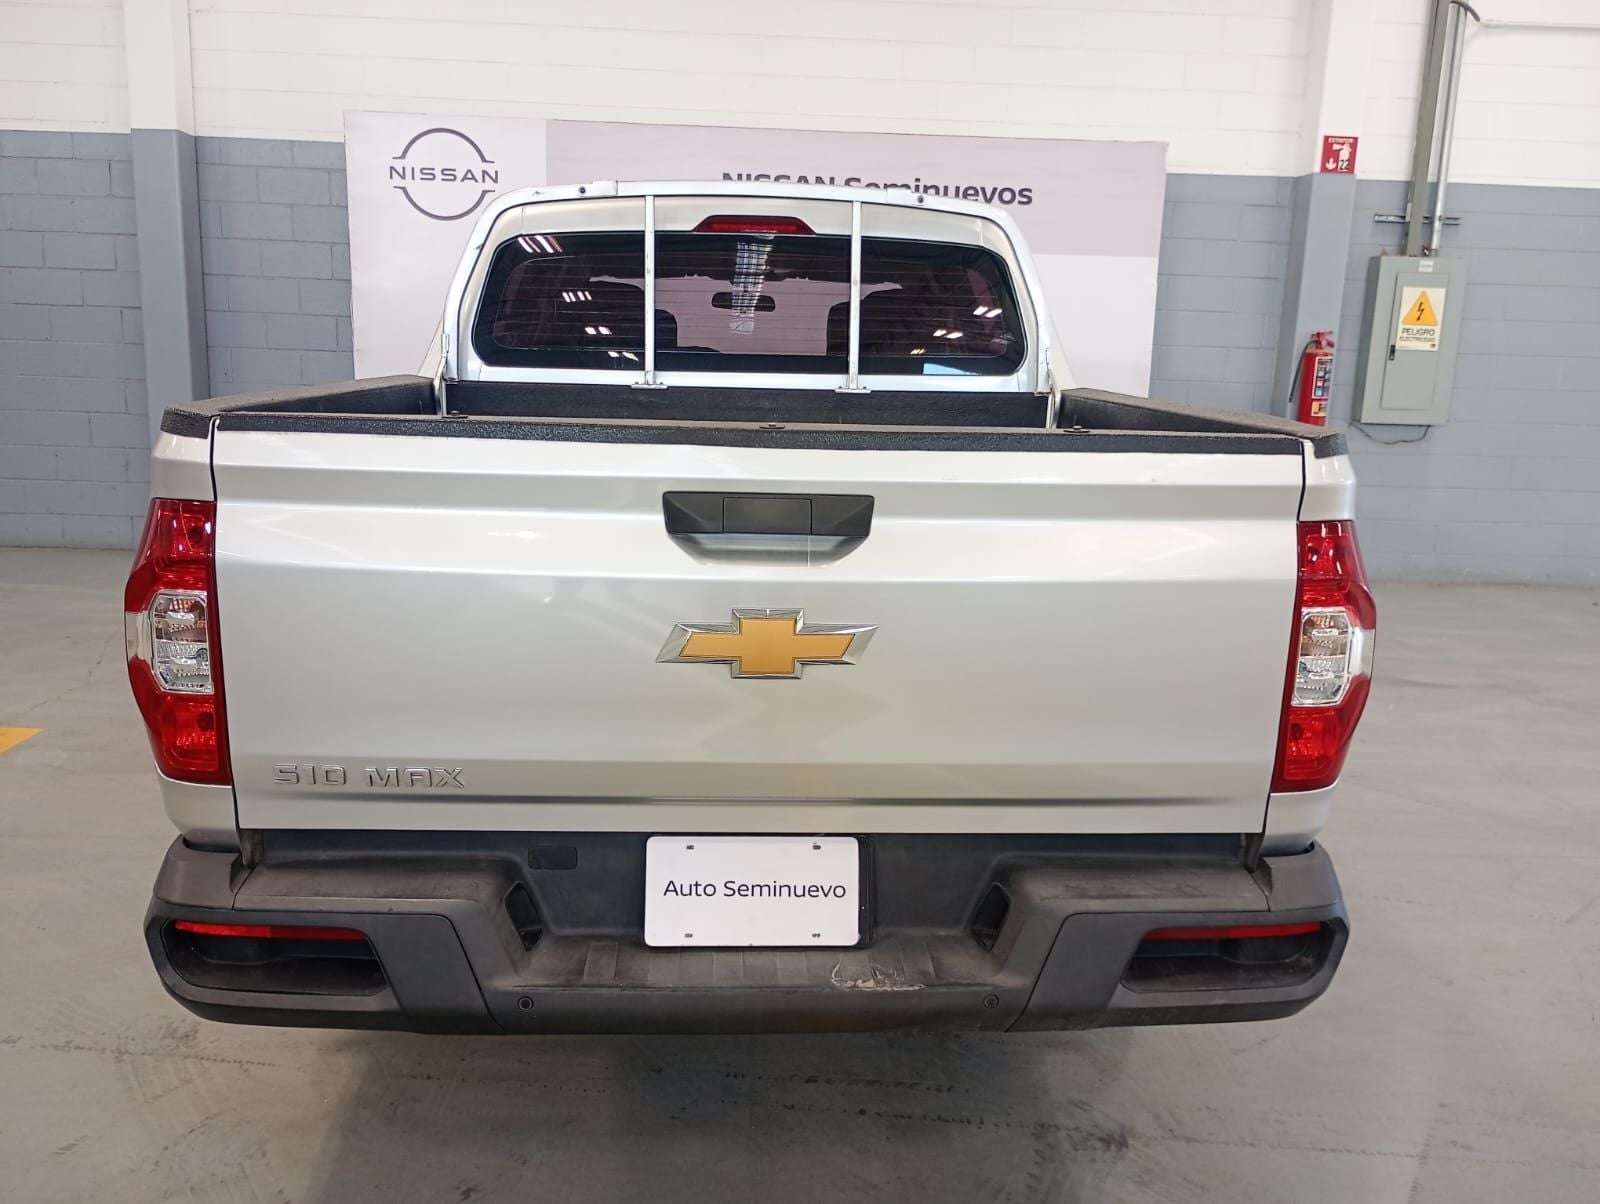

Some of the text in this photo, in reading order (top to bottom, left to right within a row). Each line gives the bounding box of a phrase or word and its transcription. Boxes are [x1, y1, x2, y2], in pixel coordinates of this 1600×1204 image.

[389, 166, 499, 184] NISSAN
[1401, 328, 1436, 337] PELIGRO
[273, 763, 465, 788] S10 MAX
[663, 880, 846, 898] Auto Seminuevo
